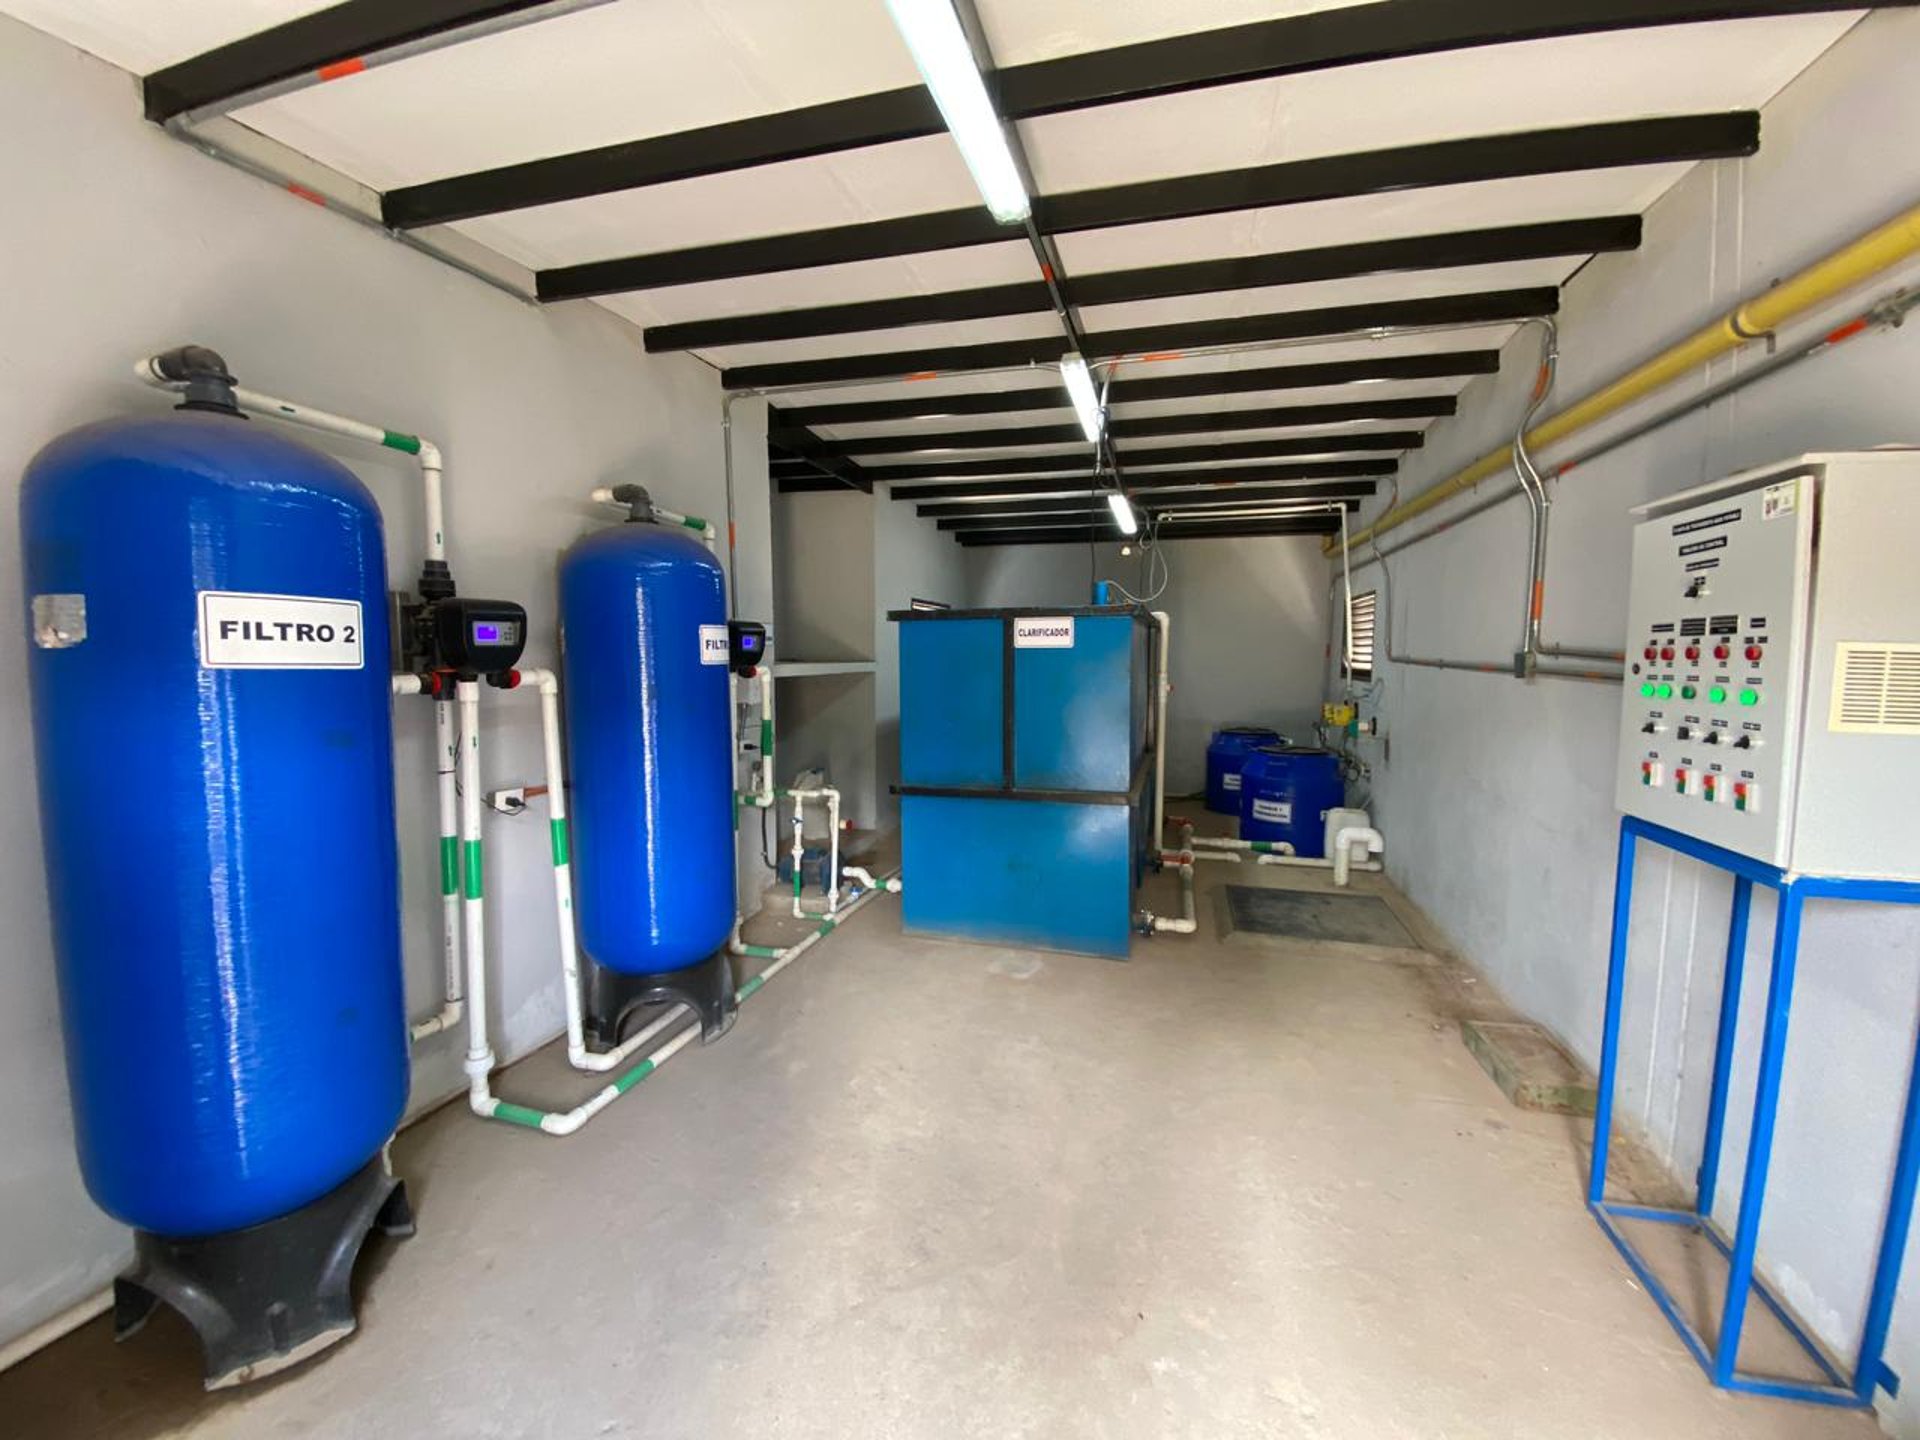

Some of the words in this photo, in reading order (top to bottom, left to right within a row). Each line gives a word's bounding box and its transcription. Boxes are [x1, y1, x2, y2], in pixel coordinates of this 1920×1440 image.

[220, 620, 335, 643] FILTRO
[343, 626, 355, 643] 2
[1018, 628, 1069, 637] CLARIFICADOR
